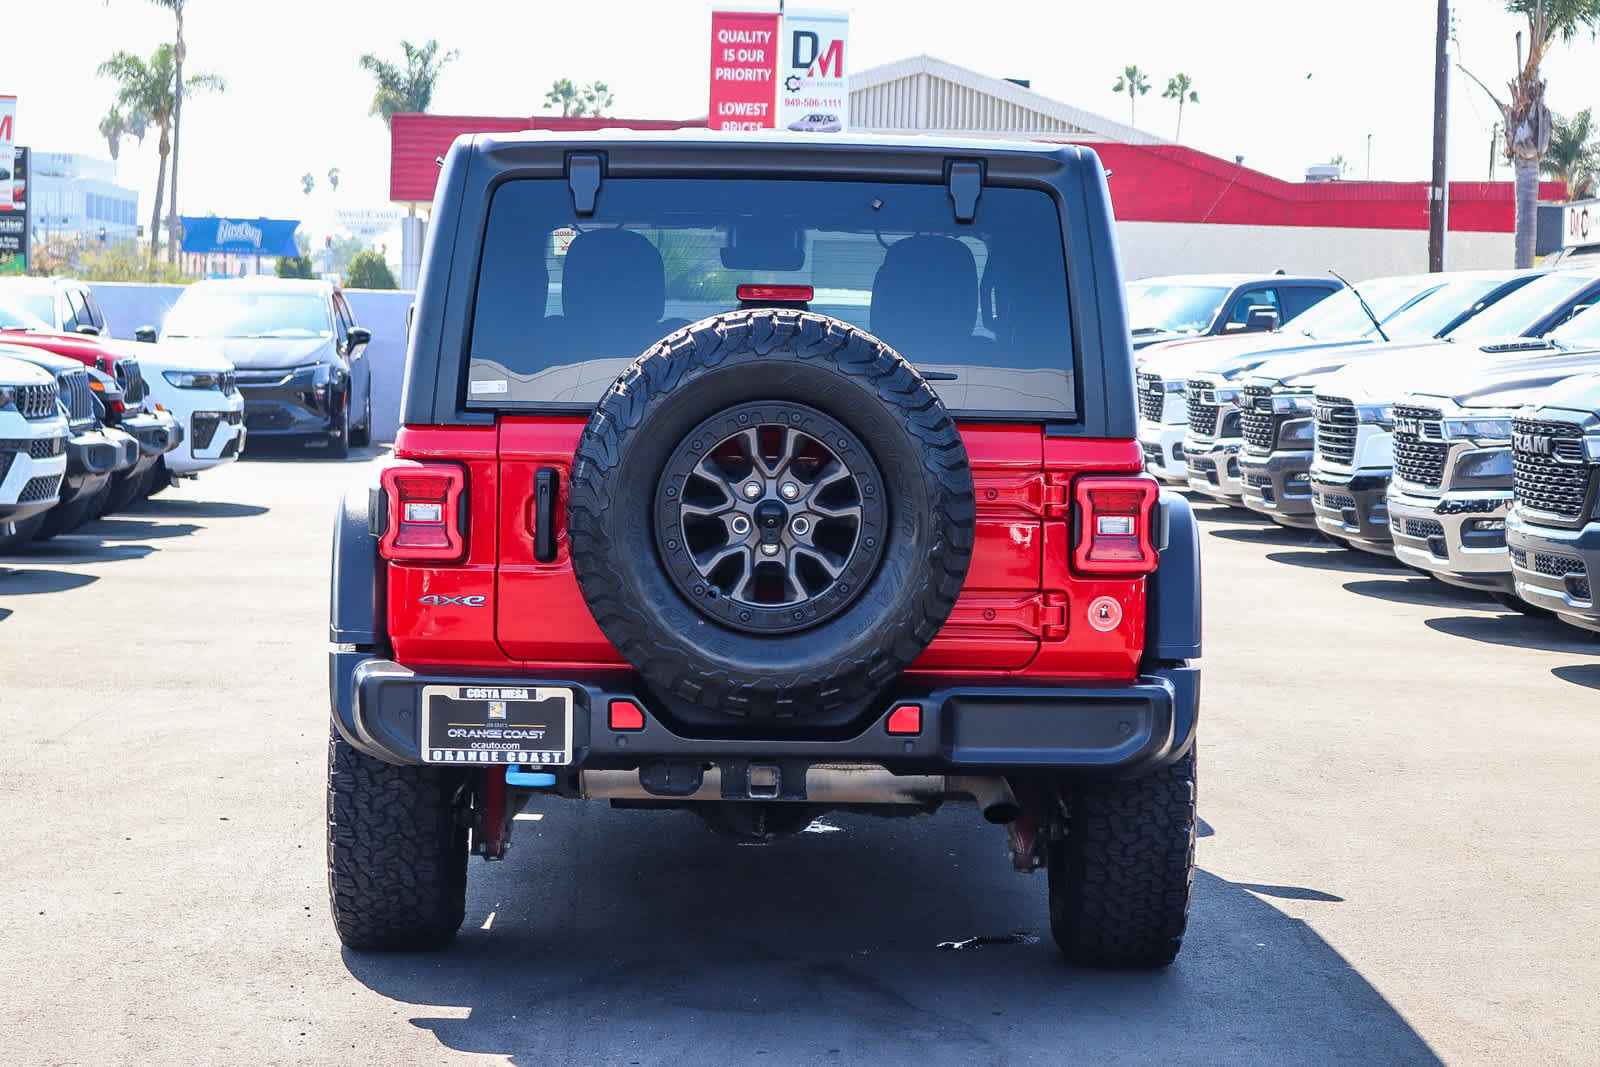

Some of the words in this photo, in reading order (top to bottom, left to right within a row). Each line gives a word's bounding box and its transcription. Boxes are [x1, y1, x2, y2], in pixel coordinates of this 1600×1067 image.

[717, 30, 772, 44] QUALITY
[724, 49, 735, 62] IS
[738, 49, 765, 62] OUR
[715, 68, 772, 81] PRIORITY
[719, 102, 768, 116] LOWEST
[1512, 432, 1551, 455] RAM
[466, 688, 500, 699] COSTA
[501, 689, 528, 700] MESA
[448, 728, 502, 739] ORANGE
[503, 729, 545, 740] COAST
[471, 742, 520, 750] ocauto.com
[432, 750, 499, 762] ORANGE
[507, 752, 561, 763] COAST
